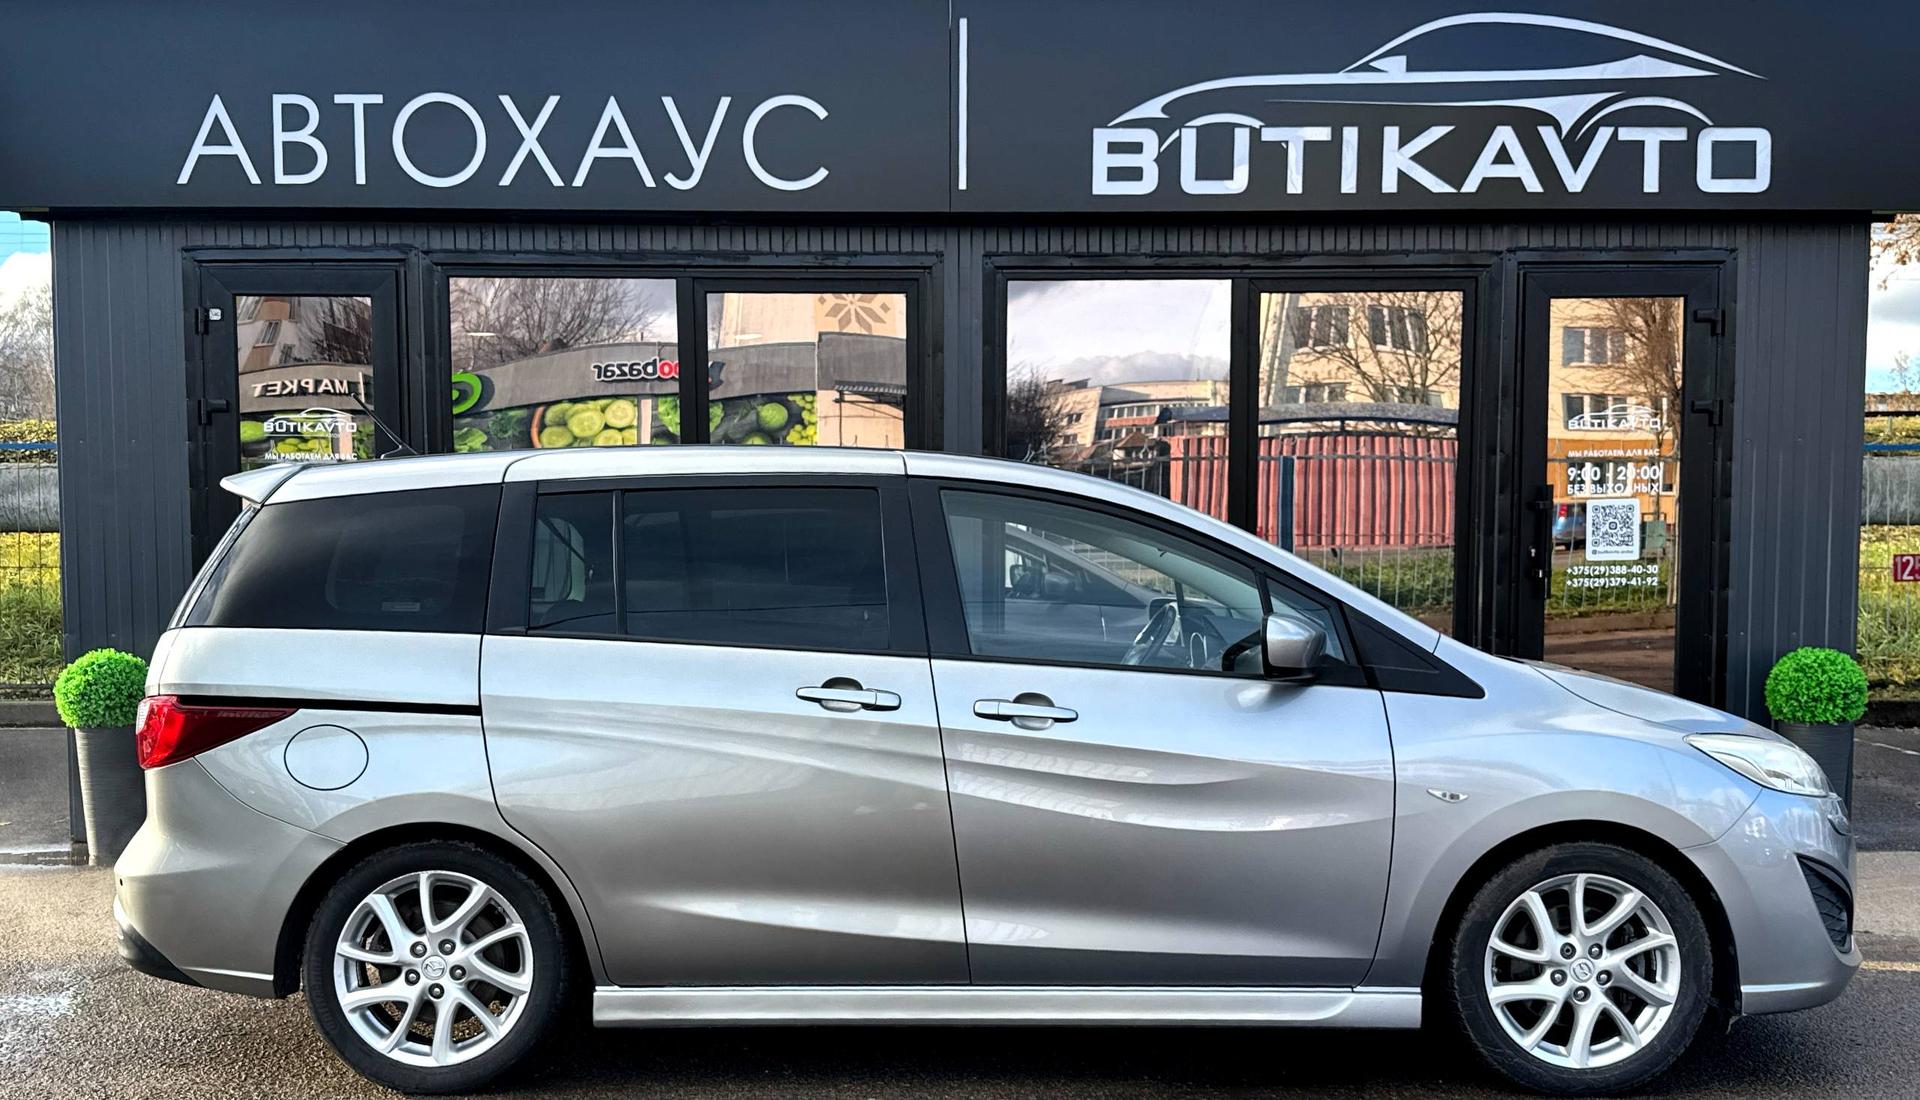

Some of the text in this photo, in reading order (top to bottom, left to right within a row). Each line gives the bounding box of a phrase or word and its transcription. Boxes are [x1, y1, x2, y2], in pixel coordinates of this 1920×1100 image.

[177, 92, 830, 191] АВТОХАУС
[1092, 126, 1772, 195] BUTIKAVTO
[264, 421, 357, 433] BUTIKAVTO
[1568, 418, 1660, 430] BUTIKAVTO
[1583, 449, 1624, 457] РАБОТАЕМ
[1567, 467, 1601, 481] 9:00
[1616, 466, 1660, 480] 20:00
[1567, 483, 1660, 494] БЕЗ ВЫХОДНЫХ
[1566, 565, 1658, 575] +375(29)388-40-30
[1566, 577, 1658, 587] +375(29)379-41-92
